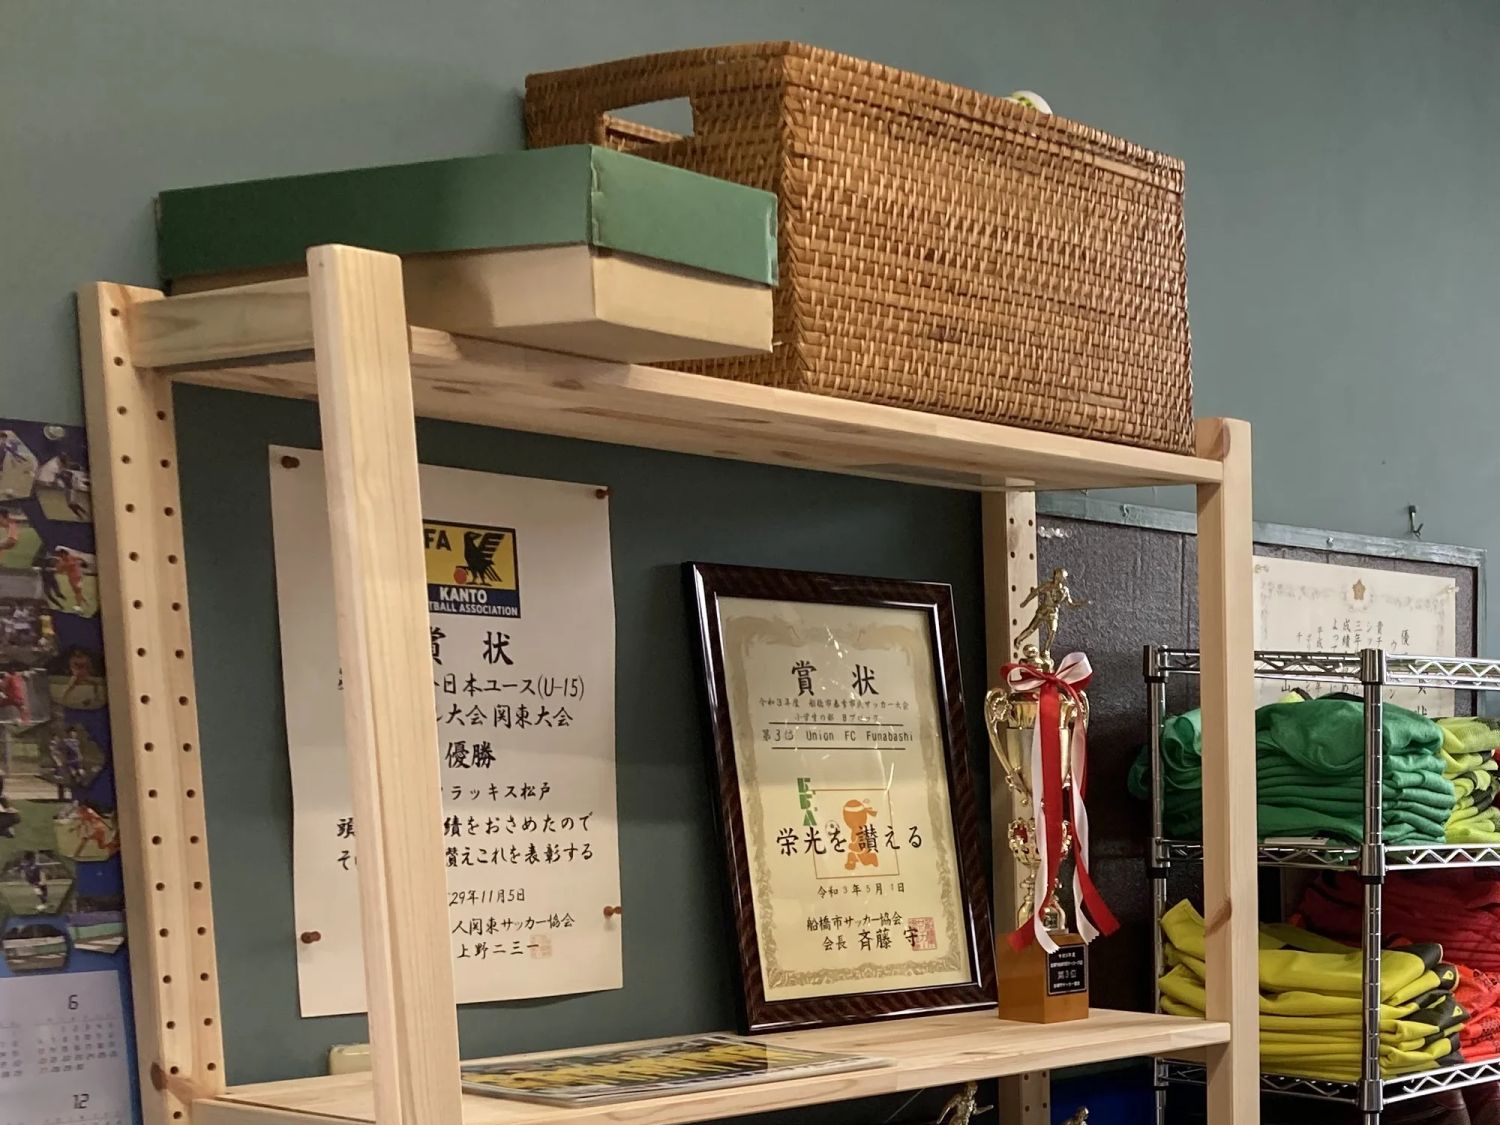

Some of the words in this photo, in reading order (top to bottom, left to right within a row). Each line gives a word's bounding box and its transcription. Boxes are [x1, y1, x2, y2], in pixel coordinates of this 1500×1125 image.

[424, 529, 452, 551] FA
[440, 586, 487, 604] KANTO
[430, 601, 457, 612] TBALL
[459, 604, 518, 616] ASSOCIATION
[434, 673, 585, 701] 日本ユース(U-15)
[806, 731, 834, 741] Union
[844, 731, 856, 741] FC
[866, 731, 913, 741] Funabashi
[445, 740, 497, 769] 優勝
[441, 782, 551, 801] ラッキス松戸
[823, 935, 848, 951] 会長
[68, 994, 78, 1010] 6
